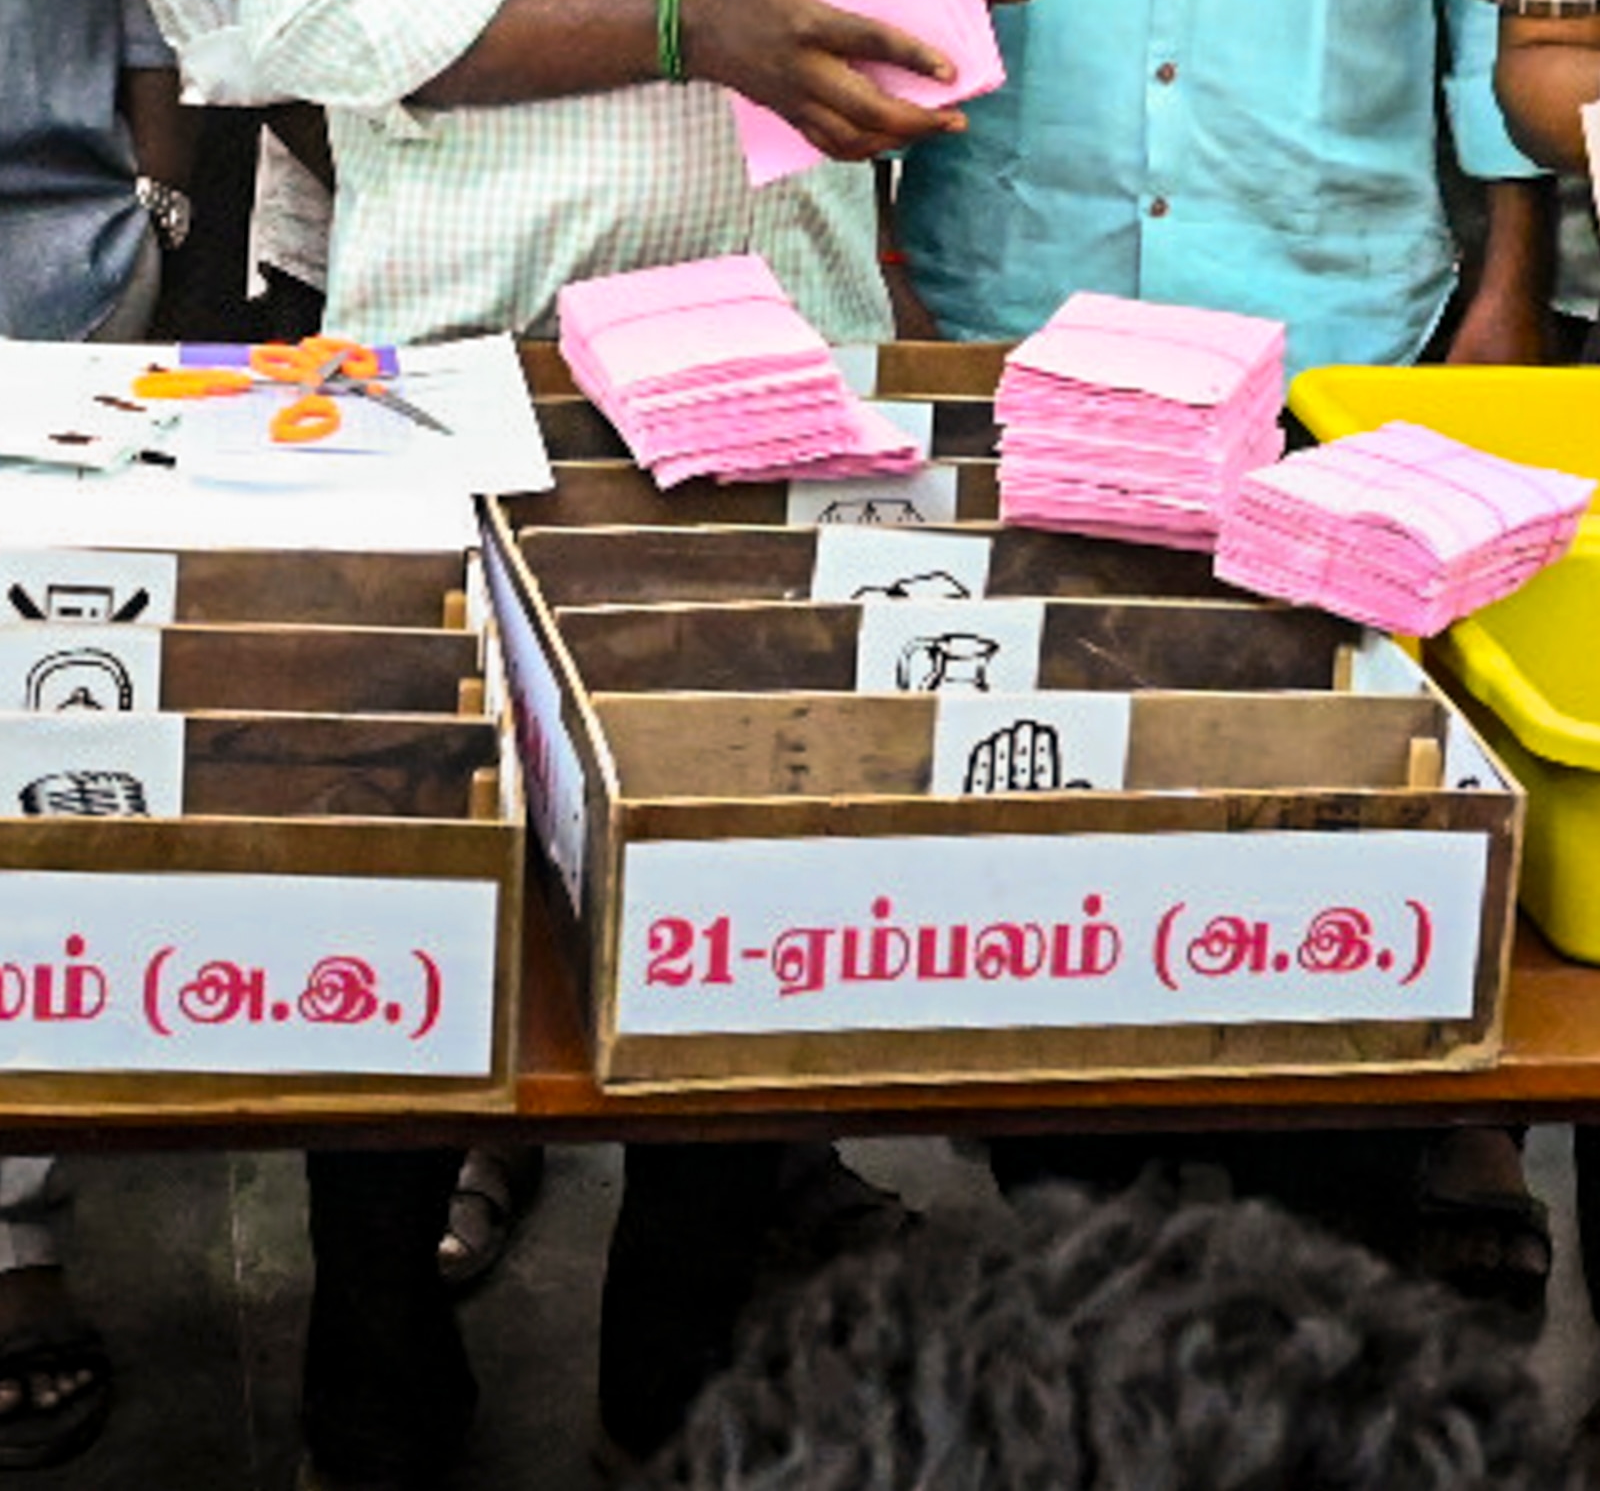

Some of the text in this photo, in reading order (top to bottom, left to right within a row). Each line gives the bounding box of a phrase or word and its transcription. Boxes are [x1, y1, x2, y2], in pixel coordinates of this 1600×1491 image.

[142, 945, 443, 1041] (அ.இ.)
[645, 892, 1434, 997] 21-ஏம்பலம் (அ.இ.)
